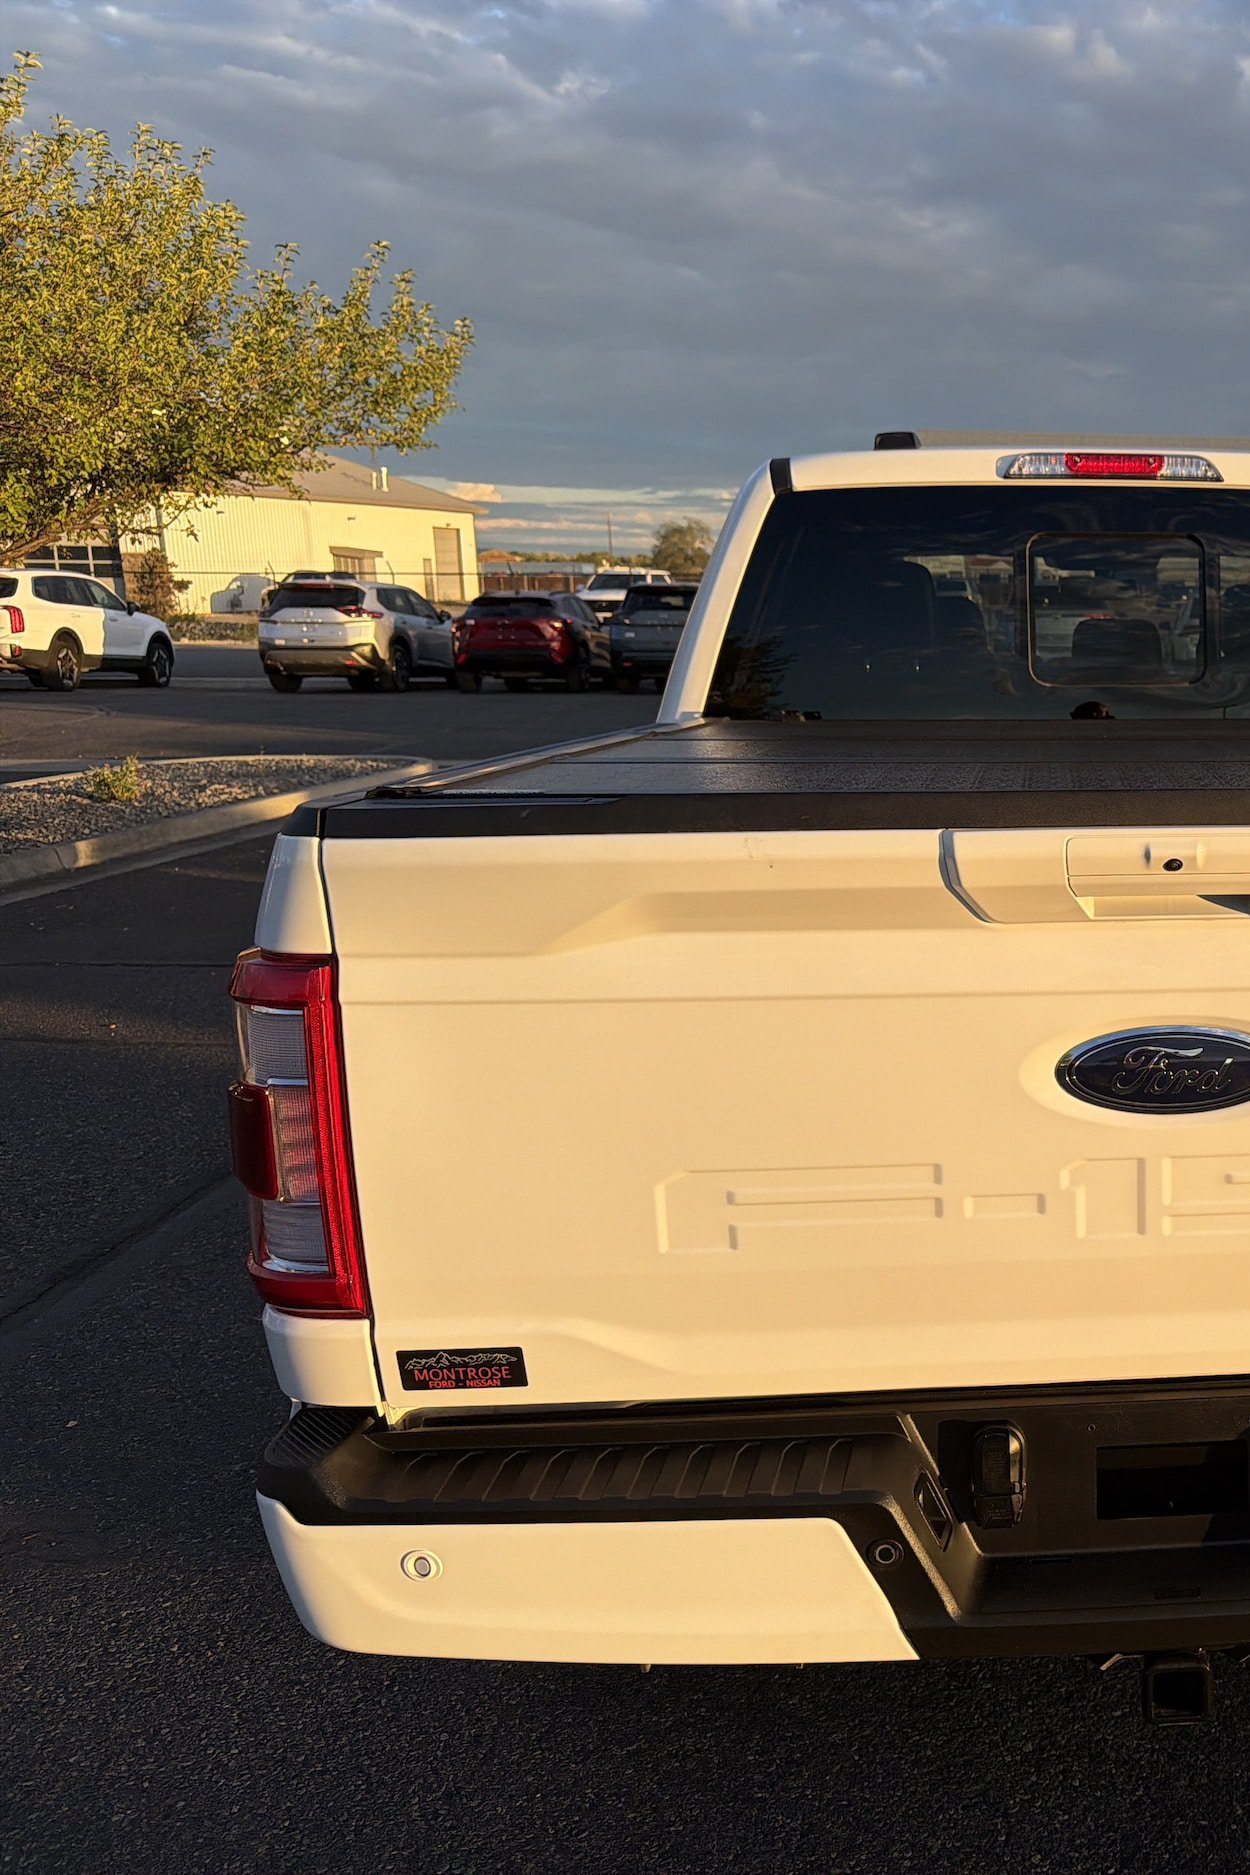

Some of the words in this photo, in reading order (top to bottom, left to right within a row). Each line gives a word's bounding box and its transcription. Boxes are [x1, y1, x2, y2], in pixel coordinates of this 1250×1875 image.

[1112, 1045, 1234, 1096] Ford
[414, 1367, 511, 1381] MONTROSE
[429, 1380, 455, 1388] FORD
[466, 1379, 500, 1387] NISSAN
